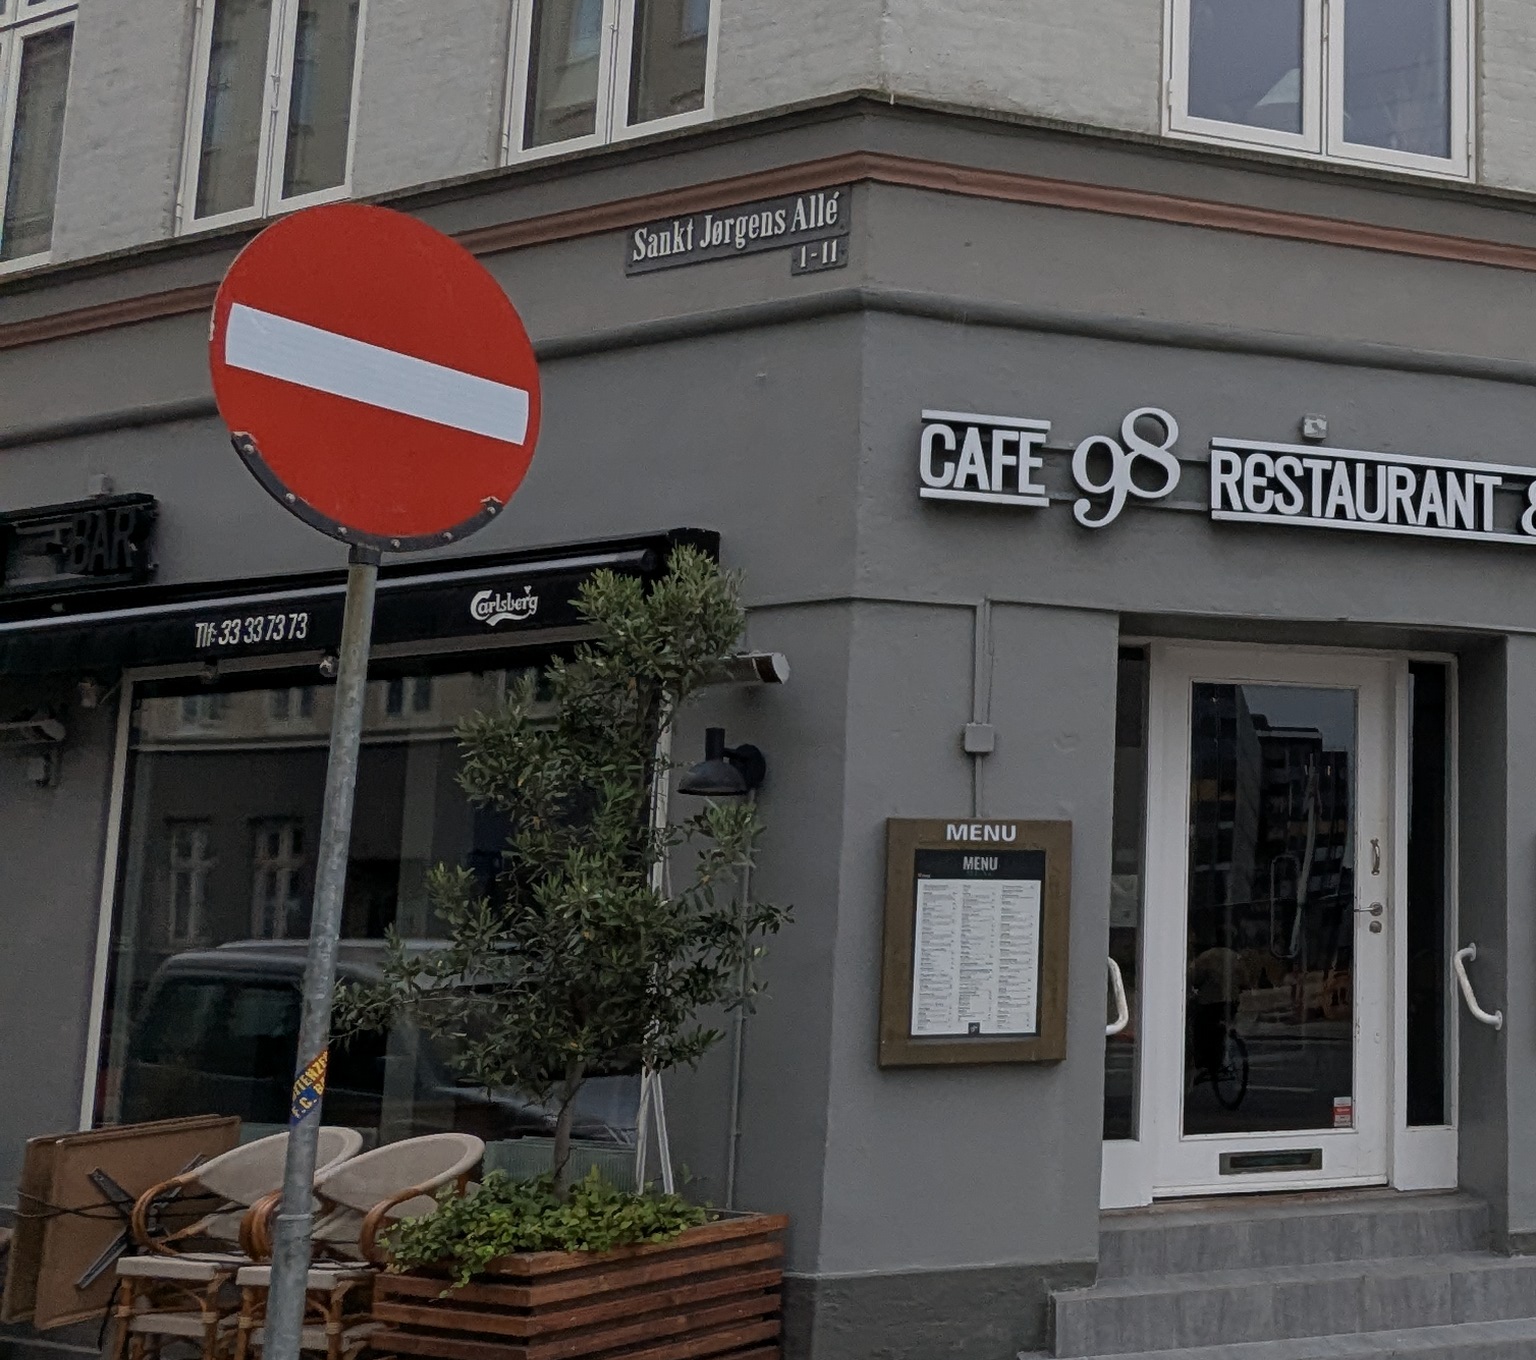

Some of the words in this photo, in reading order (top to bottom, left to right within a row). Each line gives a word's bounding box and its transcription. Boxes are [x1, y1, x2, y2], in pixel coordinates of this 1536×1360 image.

[632, 218, 695, 262] Sankt
[699, 208, 787, 250] Jørgens
[790, 190, 841, 233] Allé
[919, 422, 1048, 497] CAFE
[1071, 406, 1181, 529] 98
[1210, 447, 1503, 533] RESTAURANT
[470, 587, 540, 620] Carlsberg
[218, 618, 241, 646] 33
[244, 616, 263, 644] 33
[265, 614, 286, 642] 73
[288, 612, 309, 640] 73
[946, 823, 1017, 842] MENU
[963, 856, 998, 871] MENU
